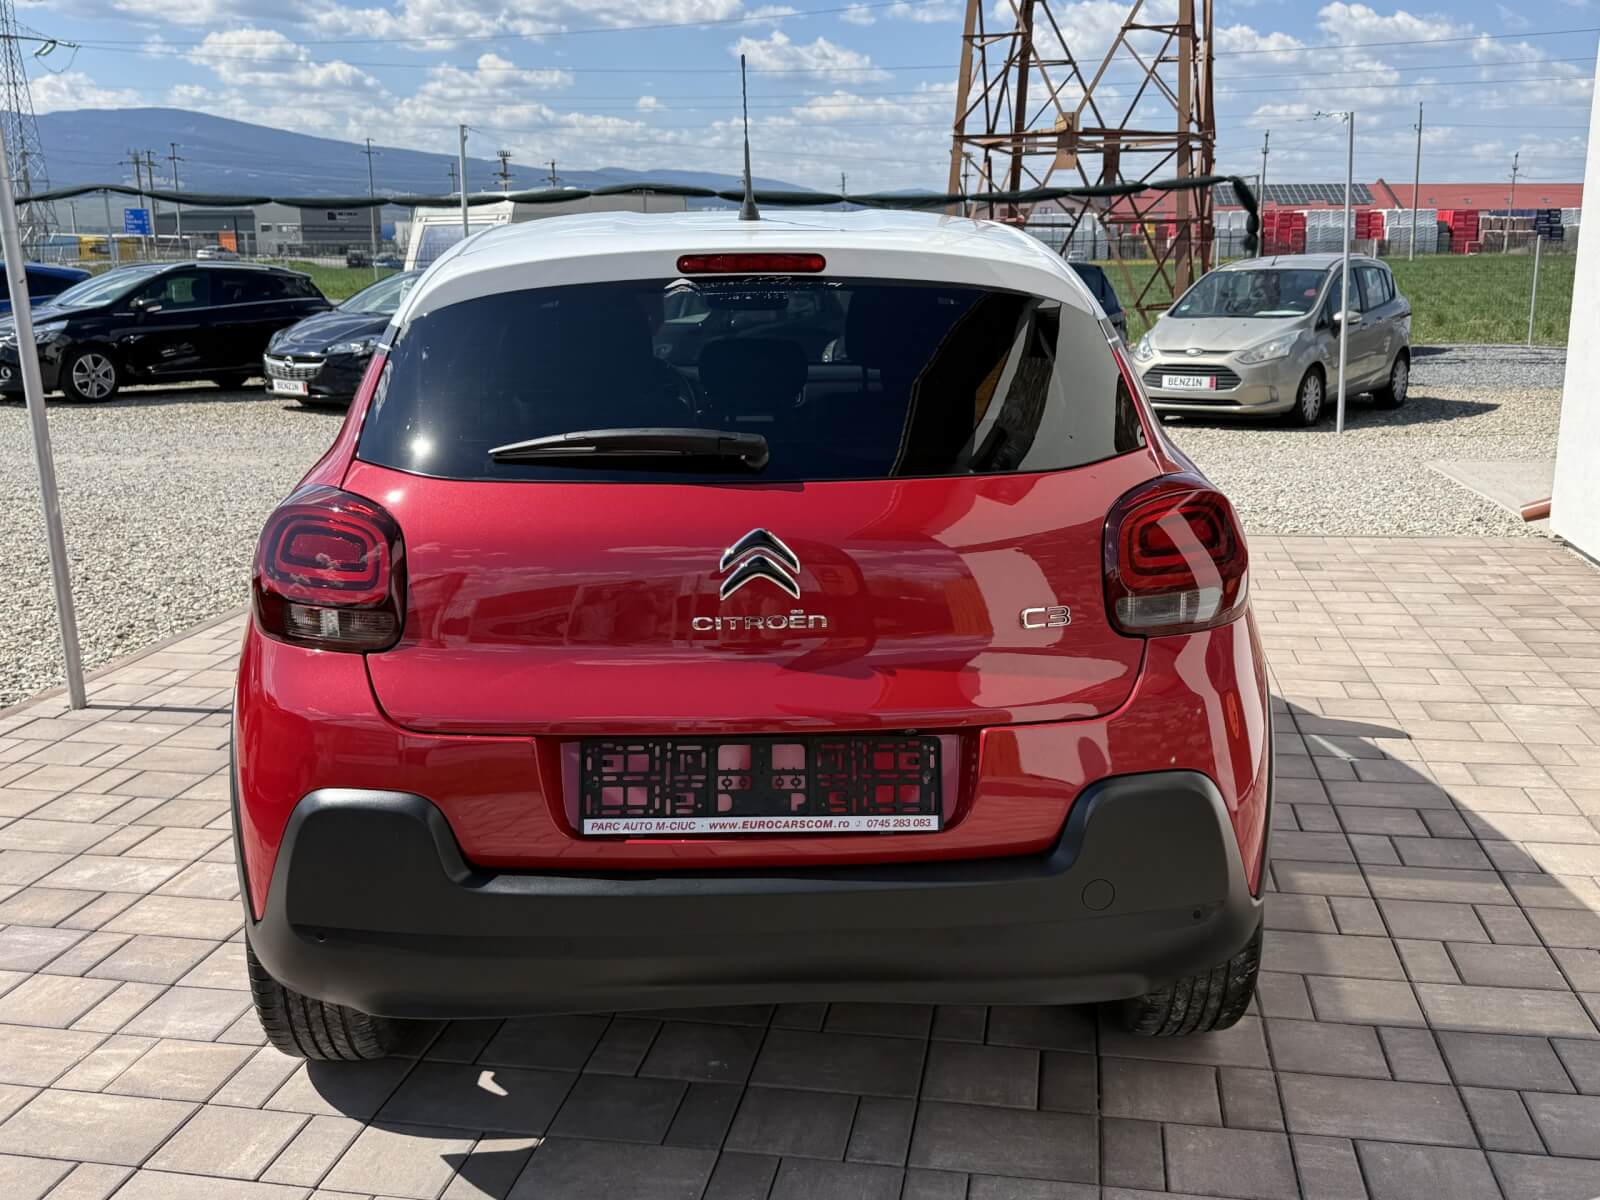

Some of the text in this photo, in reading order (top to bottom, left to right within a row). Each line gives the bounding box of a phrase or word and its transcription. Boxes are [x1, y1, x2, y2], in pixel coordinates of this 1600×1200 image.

[1168, 376, 1203, 387] BENZIN
[1020, 605, 1072, 629] C3
[591, 818, 931, 831] PARC AUTO M-CIUC www.EUROCARSCOM.ro 0745 283 083
